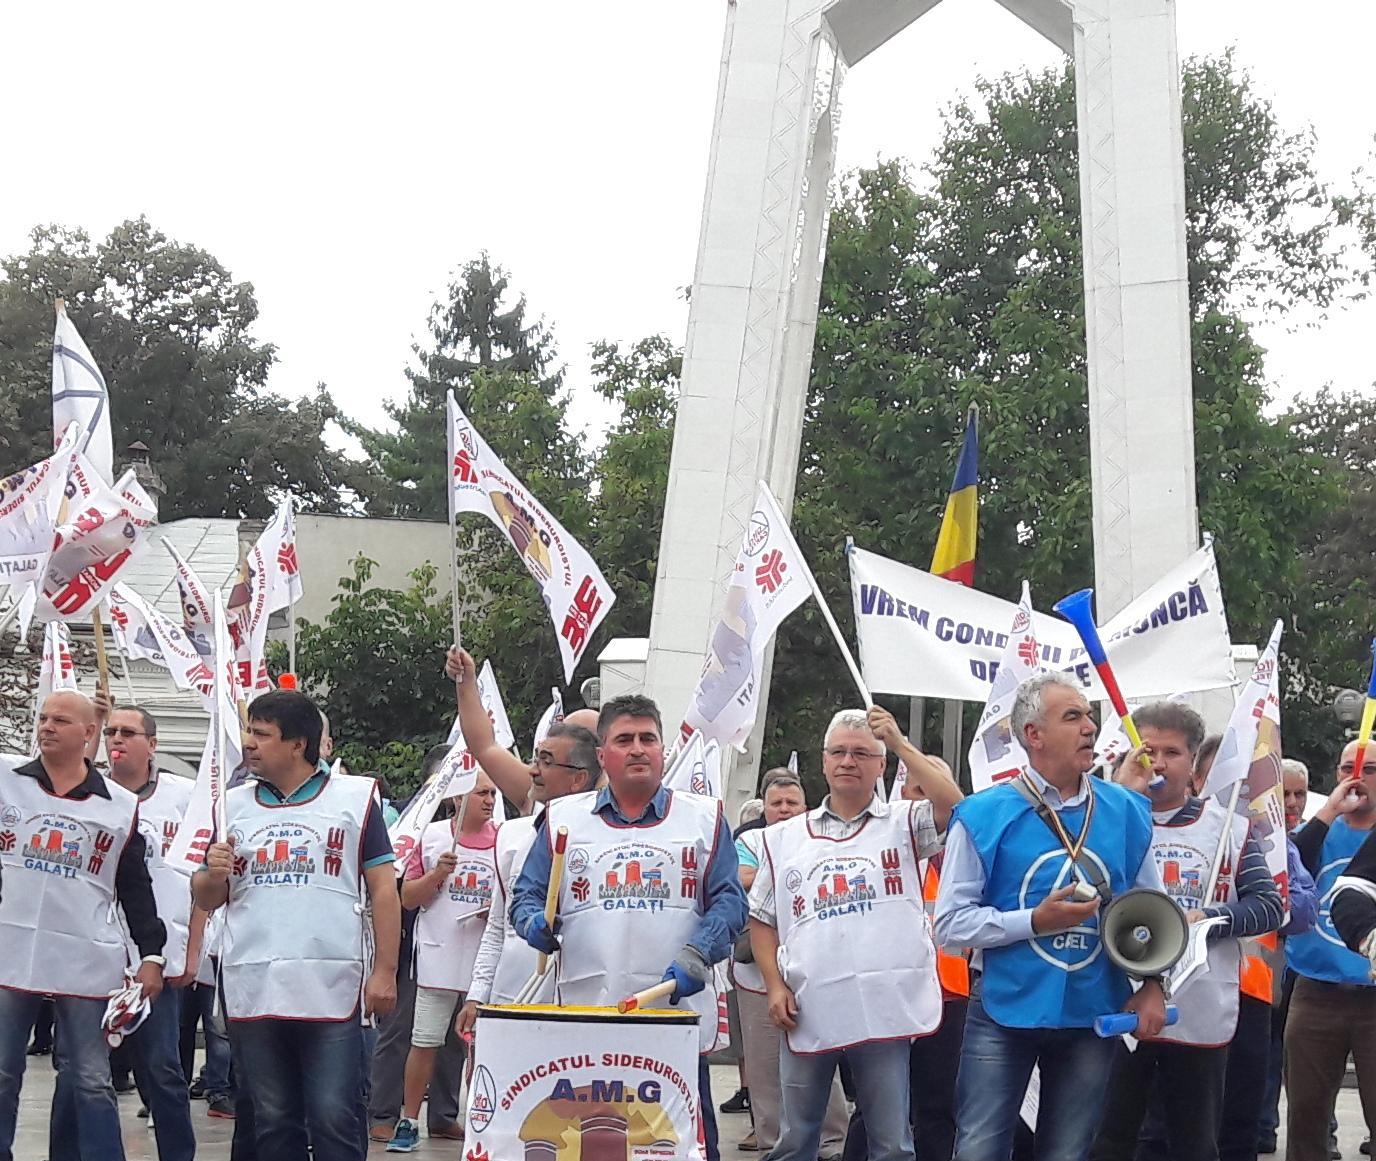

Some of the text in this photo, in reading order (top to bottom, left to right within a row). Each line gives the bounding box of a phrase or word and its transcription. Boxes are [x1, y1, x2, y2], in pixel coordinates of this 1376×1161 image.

[860, 583, 929, 631] VREM
[500, 1053, 697, 1129] SINDICATUL SIDERURGISTUL
[550, 1078, 662, 1103] A.M.G
